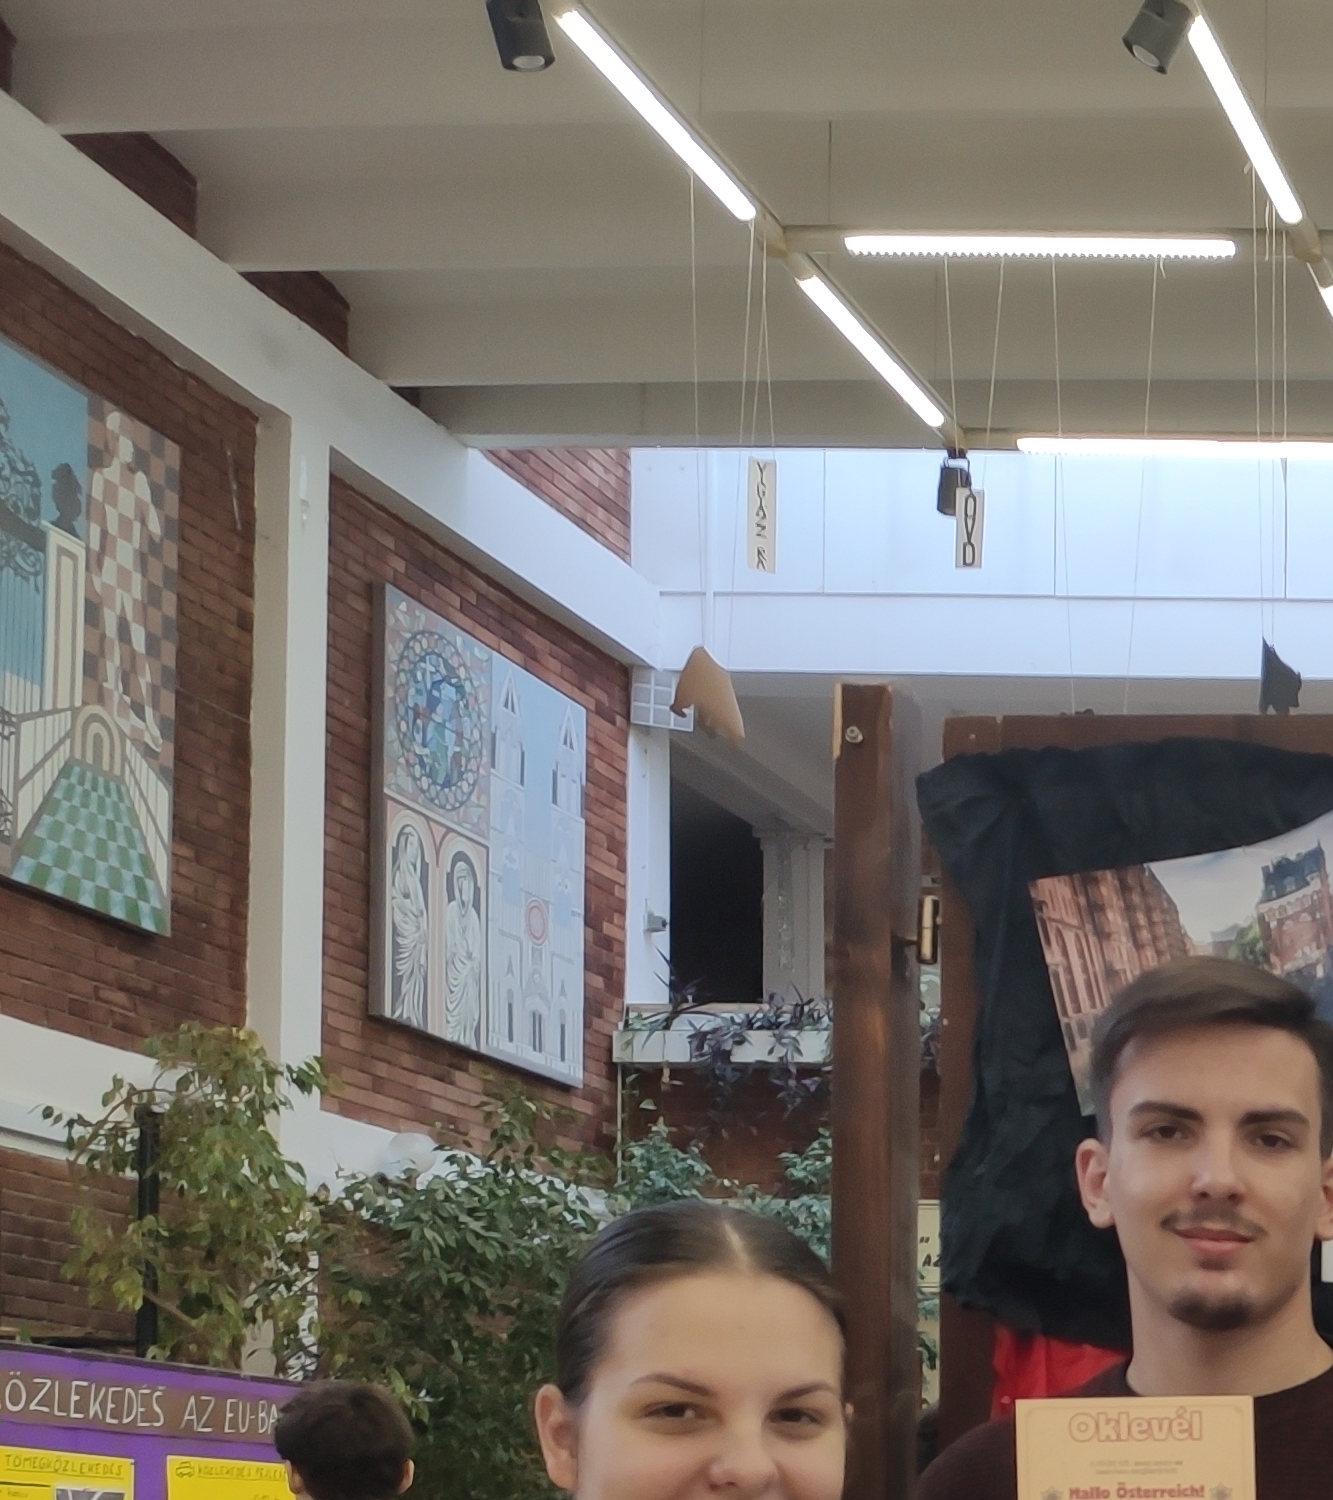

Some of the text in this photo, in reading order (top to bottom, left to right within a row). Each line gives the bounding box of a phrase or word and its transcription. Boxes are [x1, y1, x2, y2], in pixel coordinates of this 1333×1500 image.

[0, 1370, 165, 1427] ÖZLEKEDÉS
[180, 1395, 216, 1432] AZ
[1069, 1406, 1203, 1443] Oklevél
[1068, 1481, 1205, 1500] Hallo Österreich!
